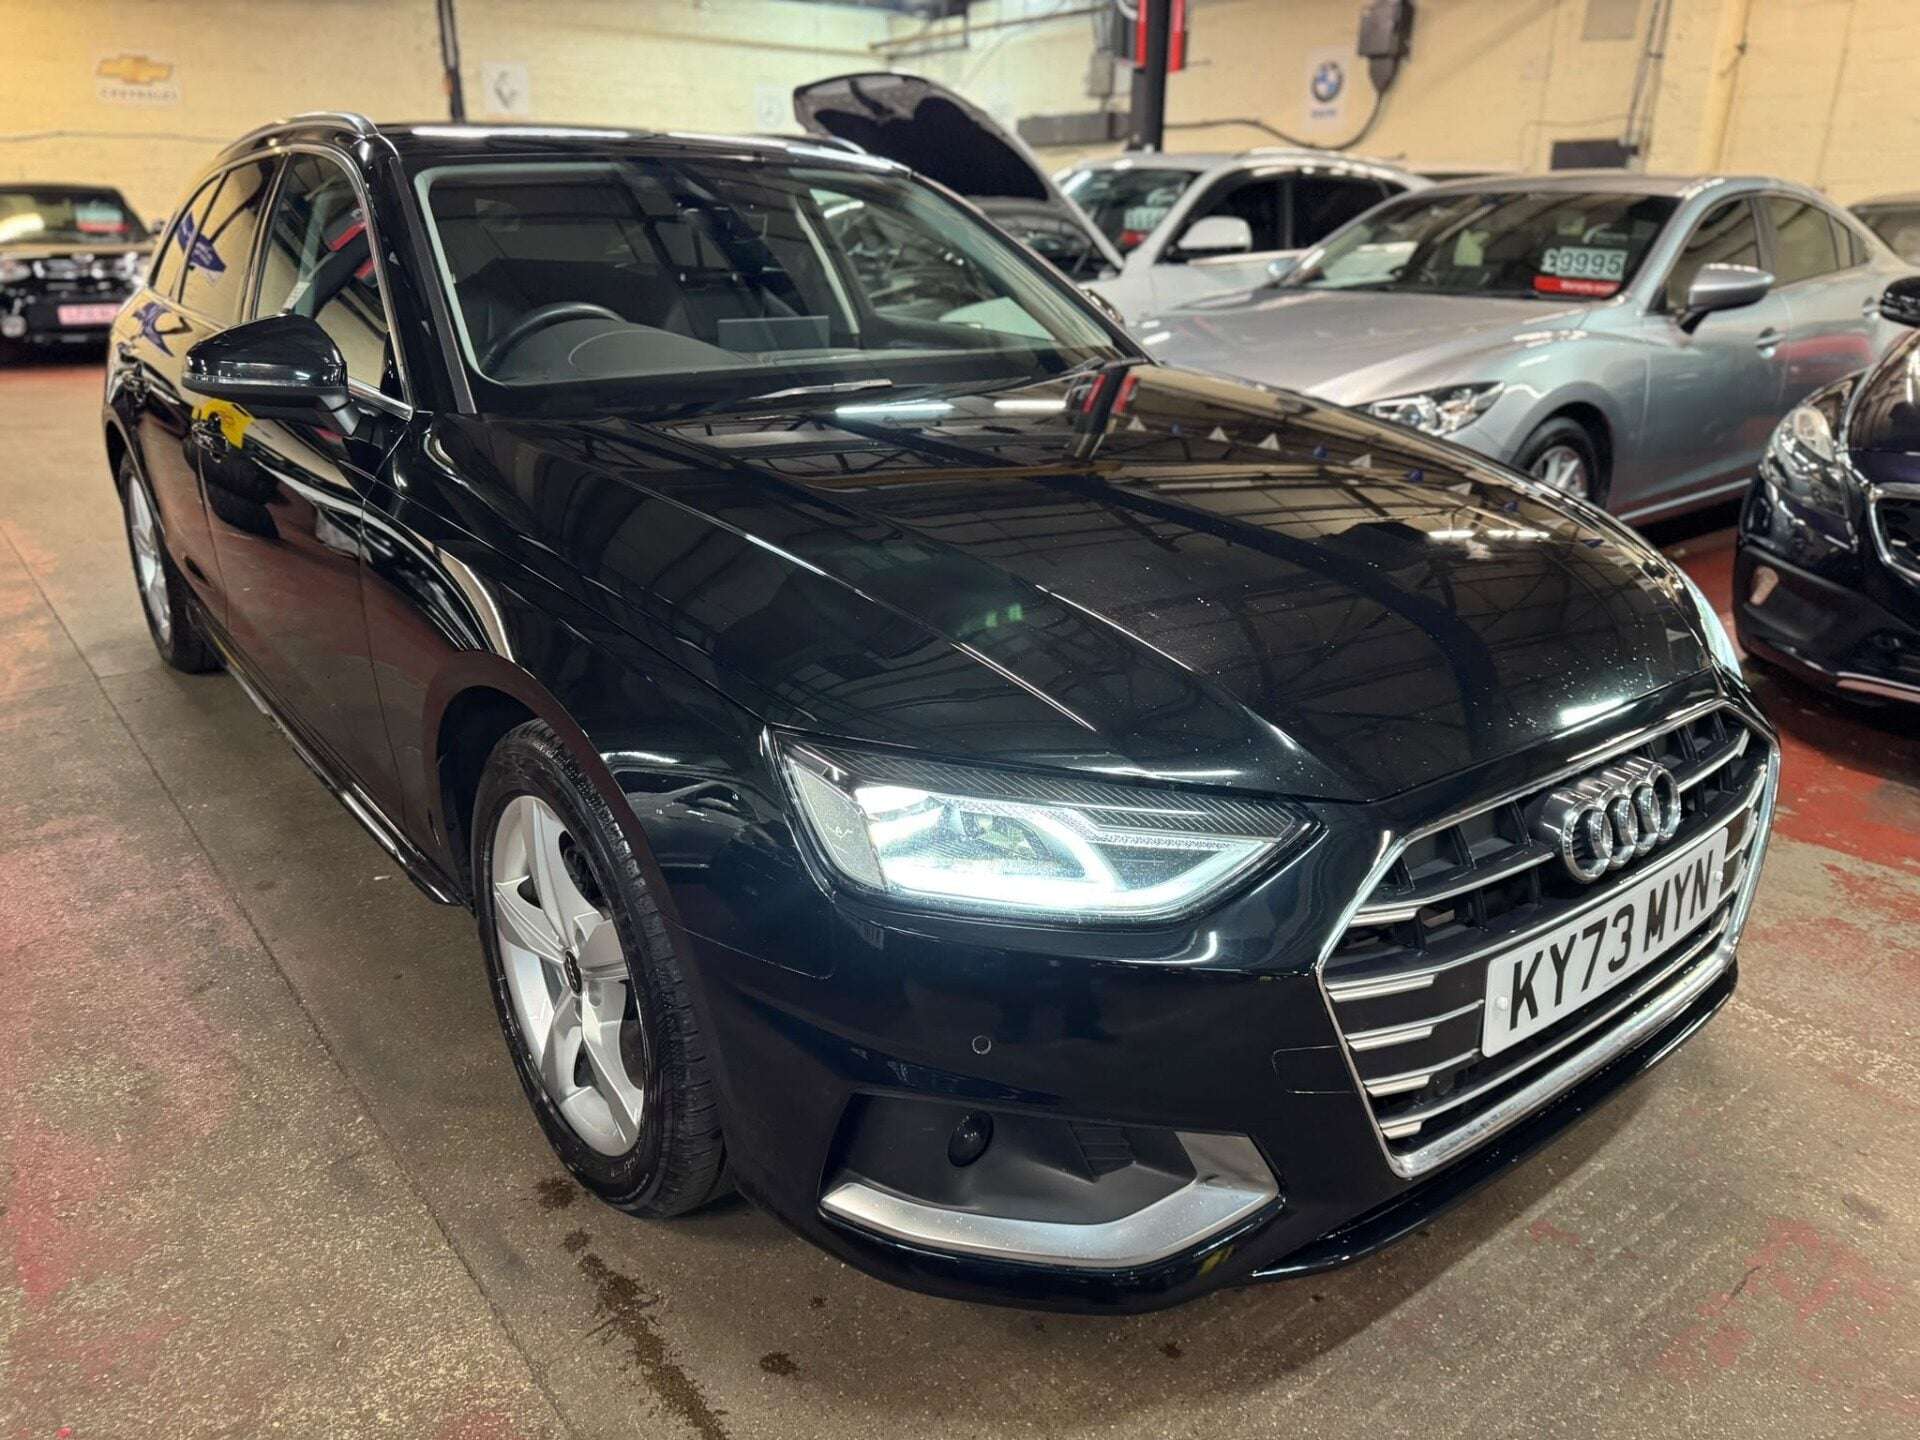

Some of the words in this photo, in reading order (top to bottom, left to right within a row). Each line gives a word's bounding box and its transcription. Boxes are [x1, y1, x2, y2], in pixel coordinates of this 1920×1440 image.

[1541, 248, 1621, 275] £9995
[1509, 903, 1634, 1031] KY73
[1643, 849, 1715, 953] MYN
